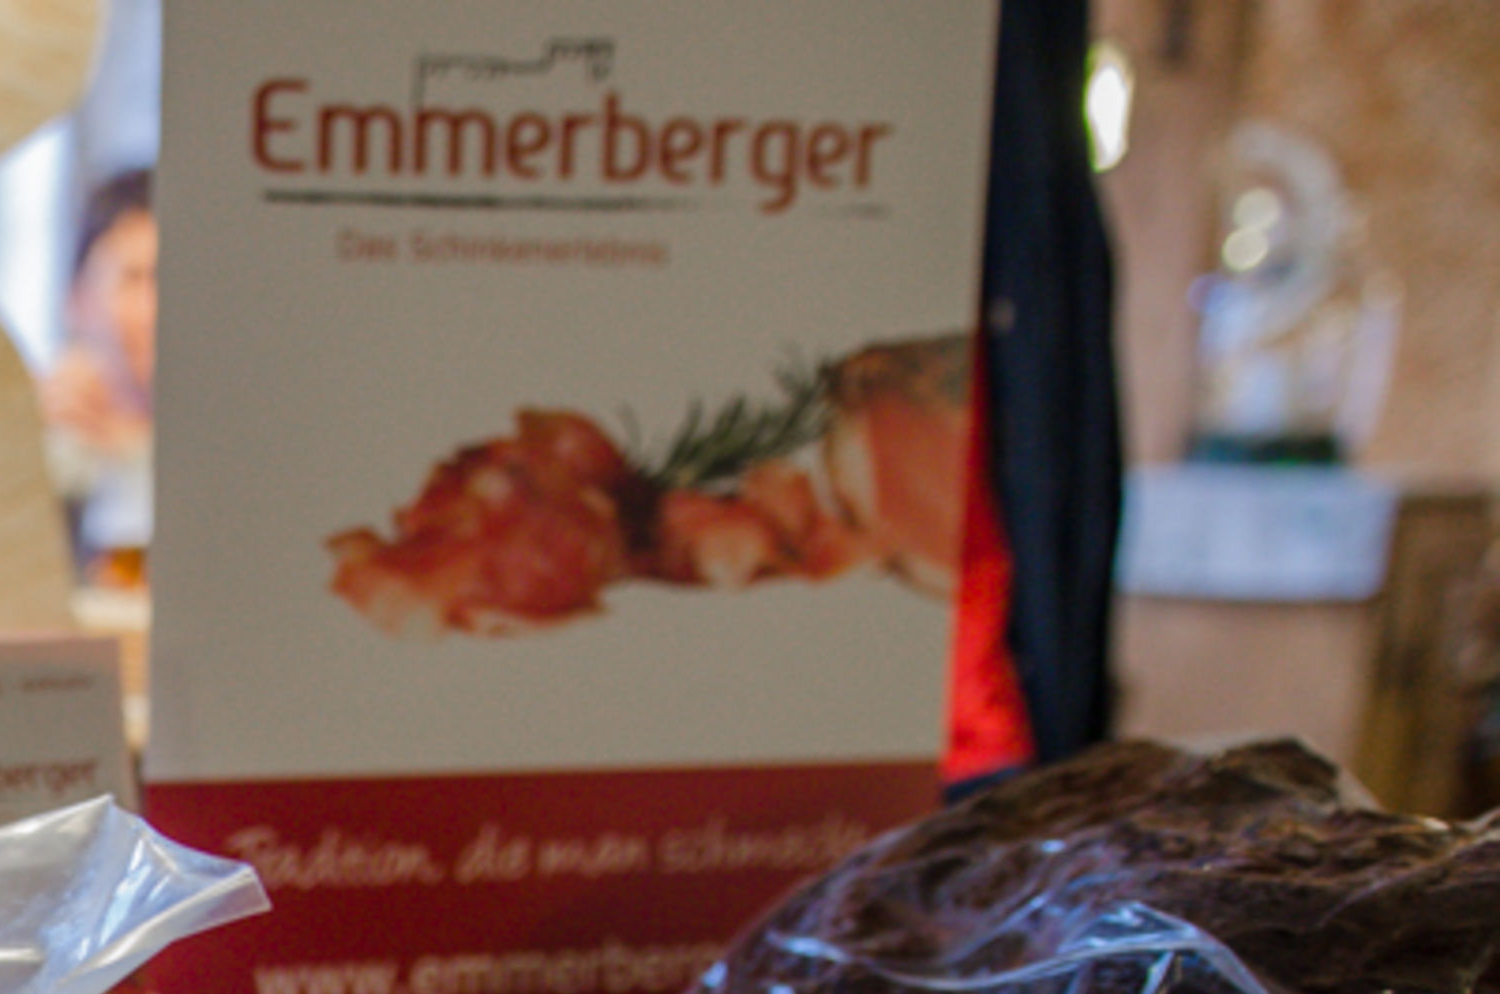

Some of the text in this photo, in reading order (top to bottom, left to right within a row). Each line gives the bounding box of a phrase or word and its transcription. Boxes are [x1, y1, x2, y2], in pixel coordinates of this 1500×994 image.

[252, 79, 891, 212] Emmerberger
[337, 229, 397, 262] Das
[538, 832, 650, 878] man
